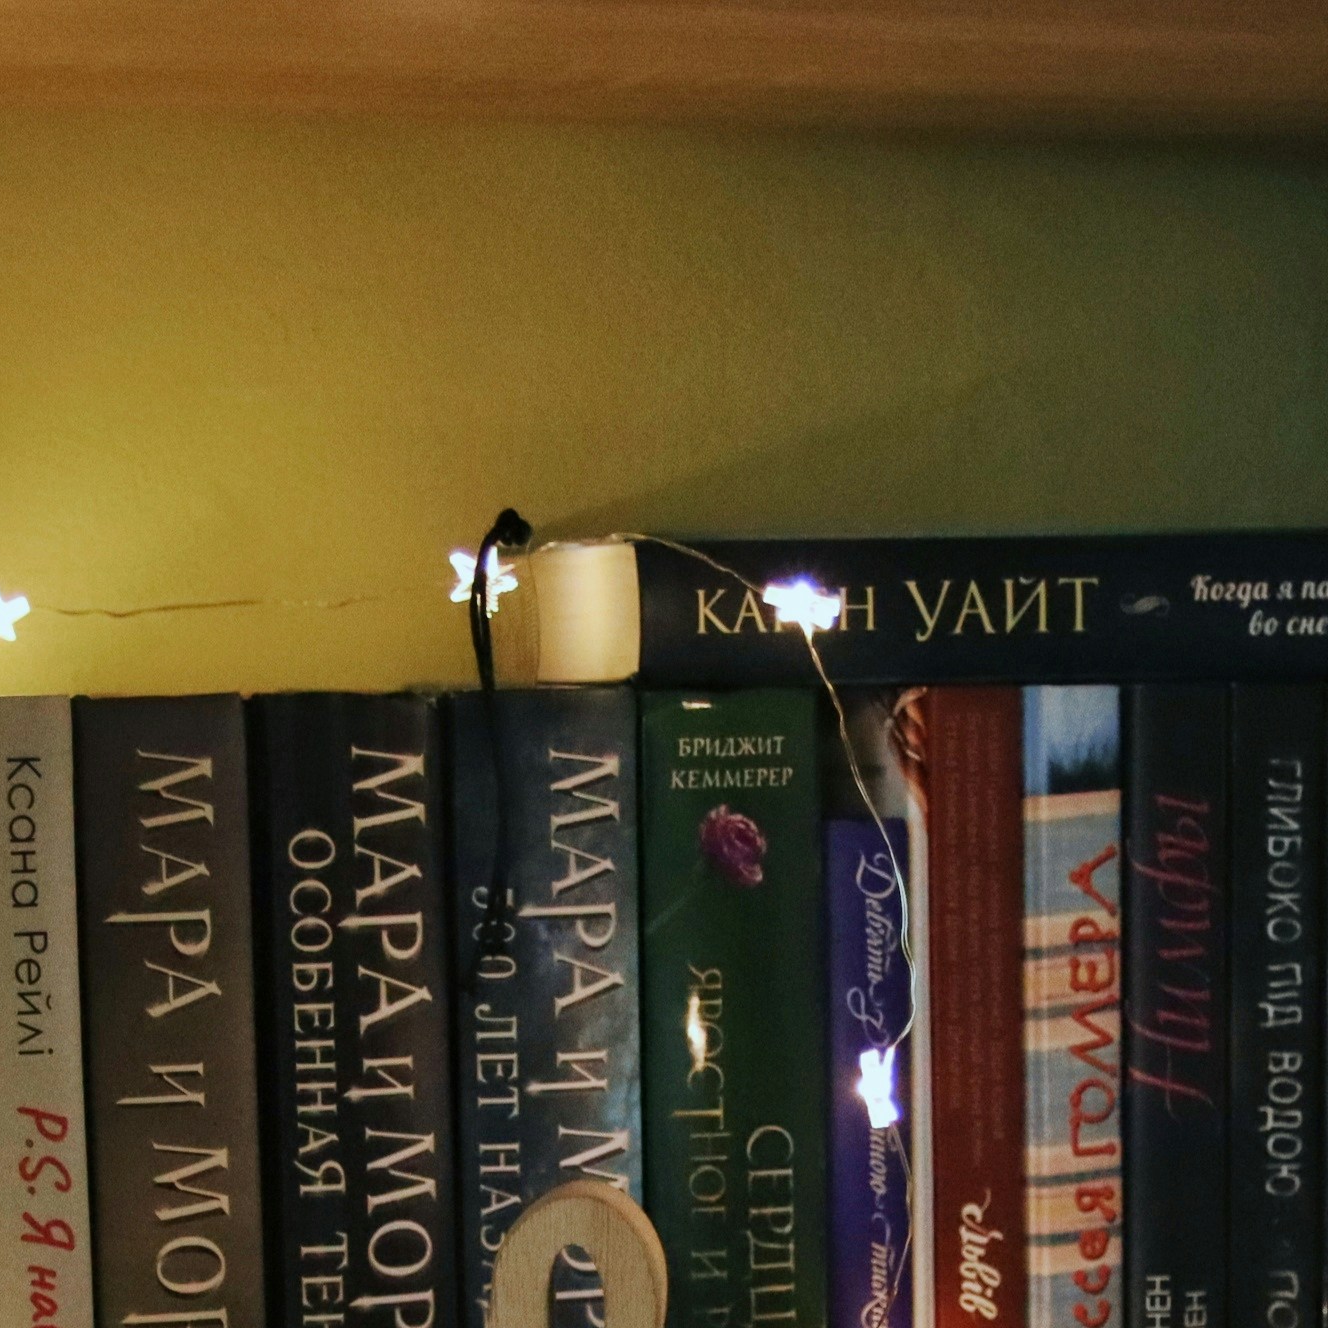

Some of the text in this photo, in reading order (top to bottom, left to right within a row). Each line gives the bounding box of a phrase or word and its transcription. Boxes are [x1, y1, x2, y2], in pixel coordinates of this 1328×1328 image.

[696, 577, 1099, 642] КАН УАЙТ
[1190, 574, 1269, 608] Когда
[1276, 581, 1294, 600] я
[1248, 610, 1279, 637] во
[670, 767, 794, 790] КЕММЕРЕР
[677, 735, 786, 757] БРИДЖИТ
[5, 756, 54, 1056] Ксана Рейлі
[102, 748, 223, 1019] МАРА
[337, 743, 433, 1041] МАРА
[517, 748, 623, 1018] МАРА
[1258, 758, 1304, 1197] ГЛИБОКО ПІД ВОДОЮ
[288, 829, 347, 1199] ОСОБЕННАЯ
[473, 1003, 521, 1119] ЛЕТ
[1066, 847, 1118, 1156] ГОМЕРА
[21, 1211, 76, 1252] Я
